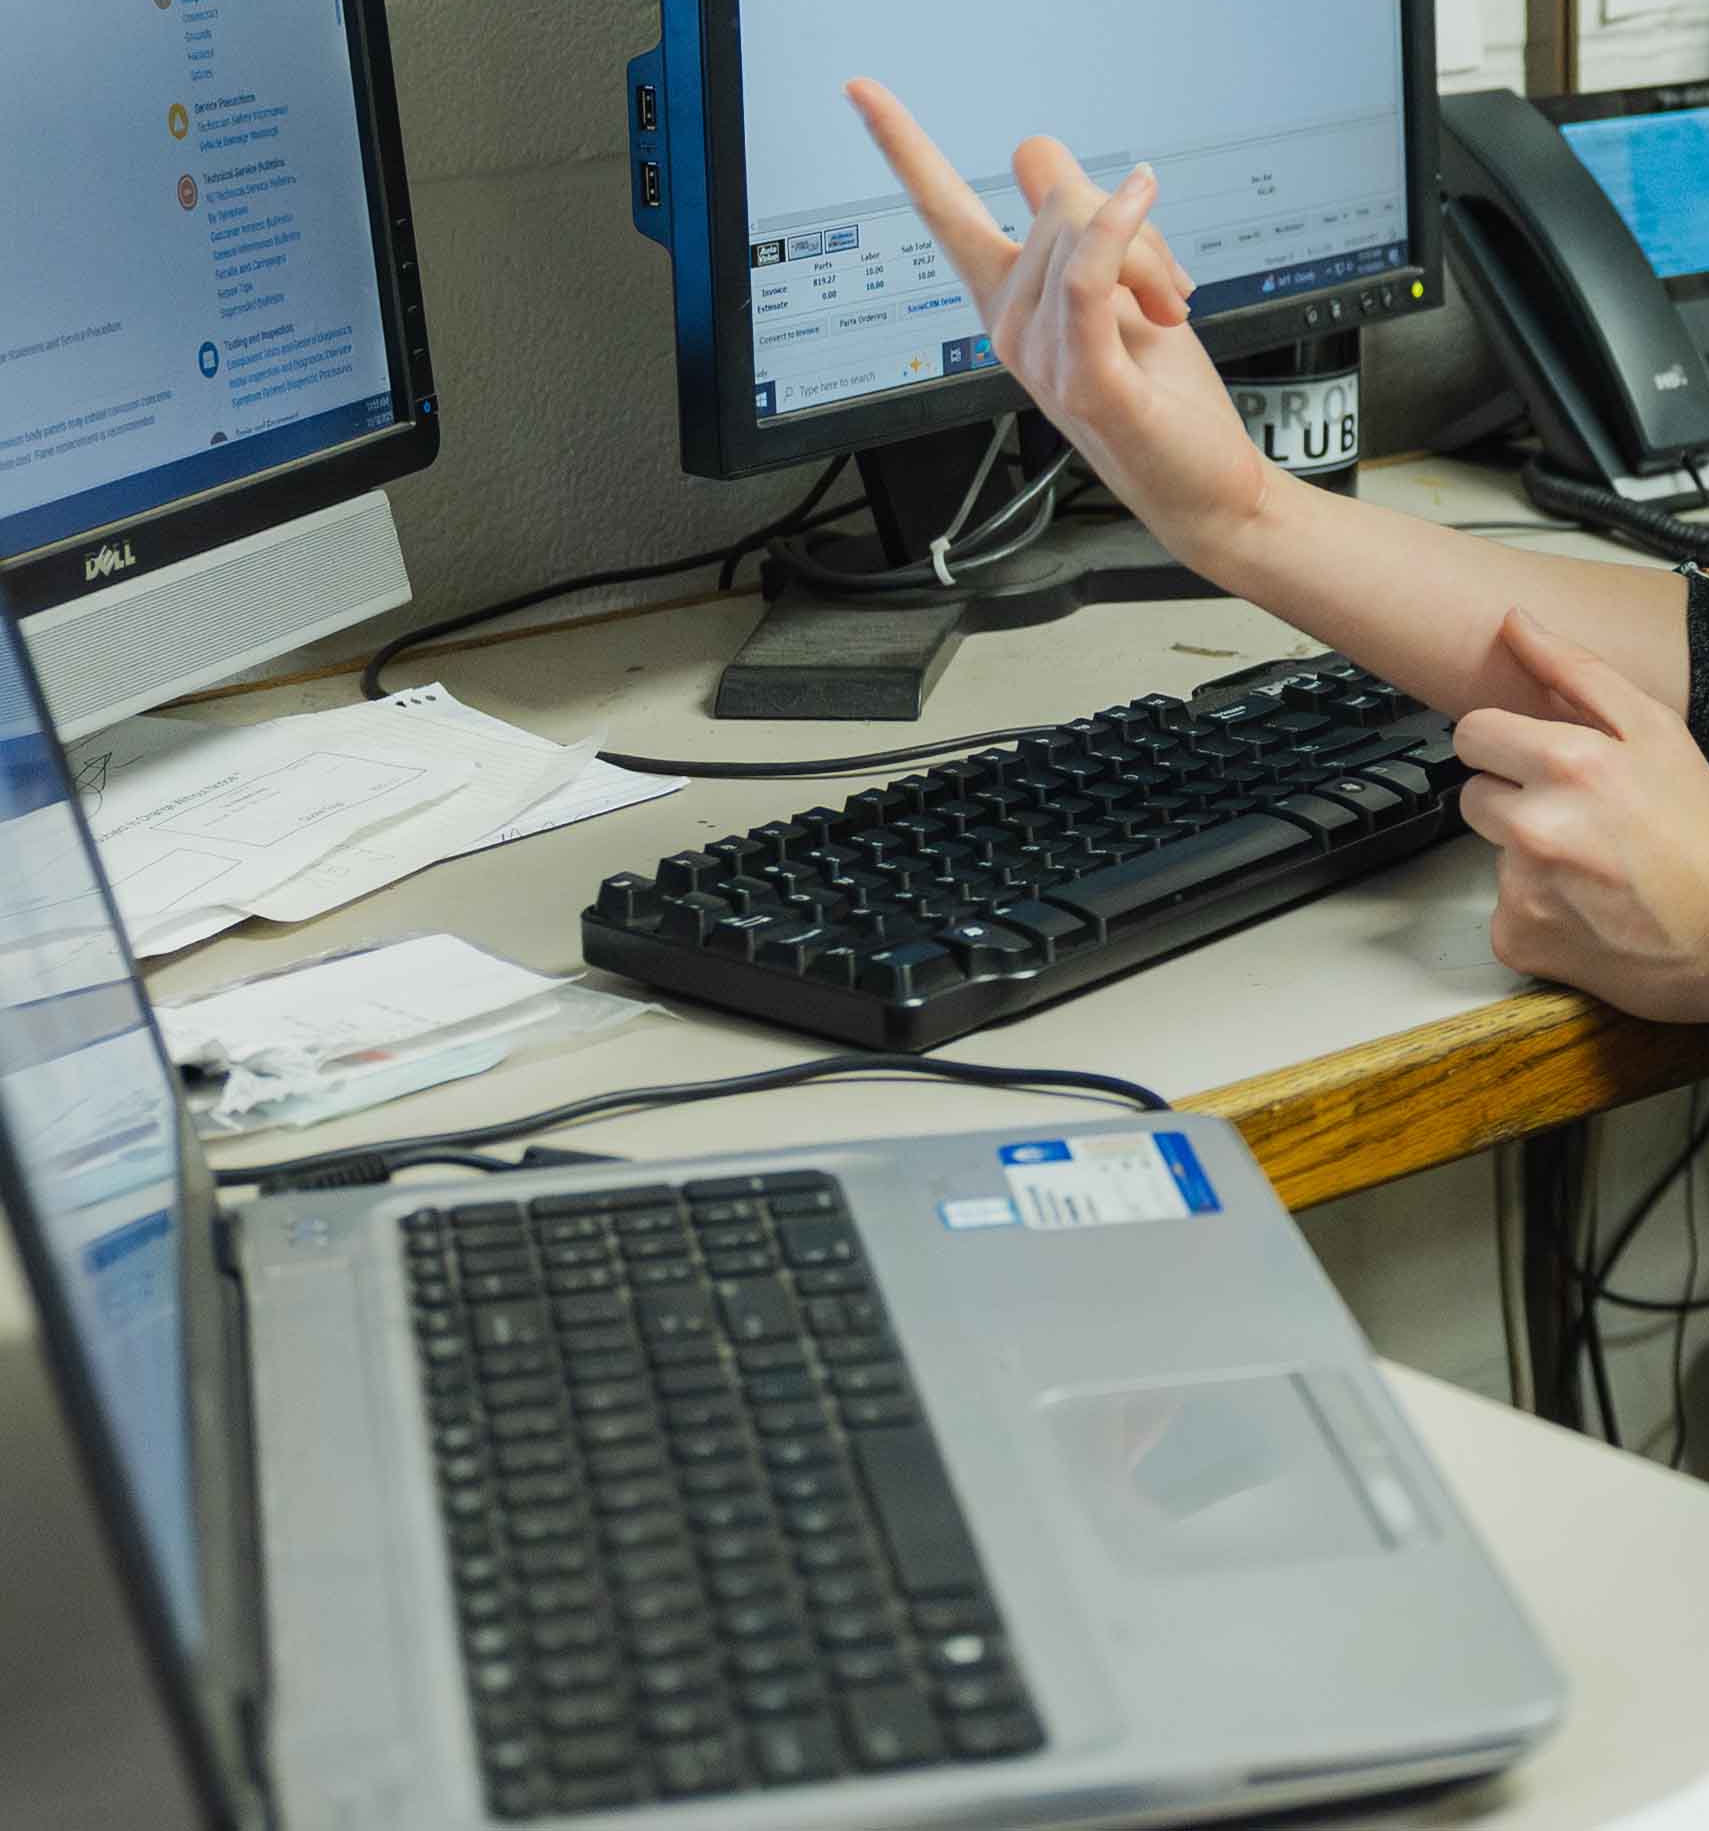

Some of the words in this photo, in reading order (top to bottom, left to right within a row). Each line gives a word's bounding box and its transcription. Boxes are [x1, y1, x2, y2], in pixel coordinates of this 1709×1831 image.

[813, 261, 833, 272] Parts
[860, 250, 881, 263] Labor
[761, 285, 788, 299] Invoice
[812, 275, 836, 288] 819.27
[757, 299, 790, 315] Estimate
[821, 289, 838, 302] 0.00
[839, 318, 858, 330] Parts
[859, 310, 888, 326] Ordering
[758, 330, 787, 346] Convert
[799, 383, 819, 399] Type
[819, 380, 839, 393] here
[849, 370, 876, 387] search
[1263, 413, 1355, 463] LUB
[85, 544, 136, 581] DELL
